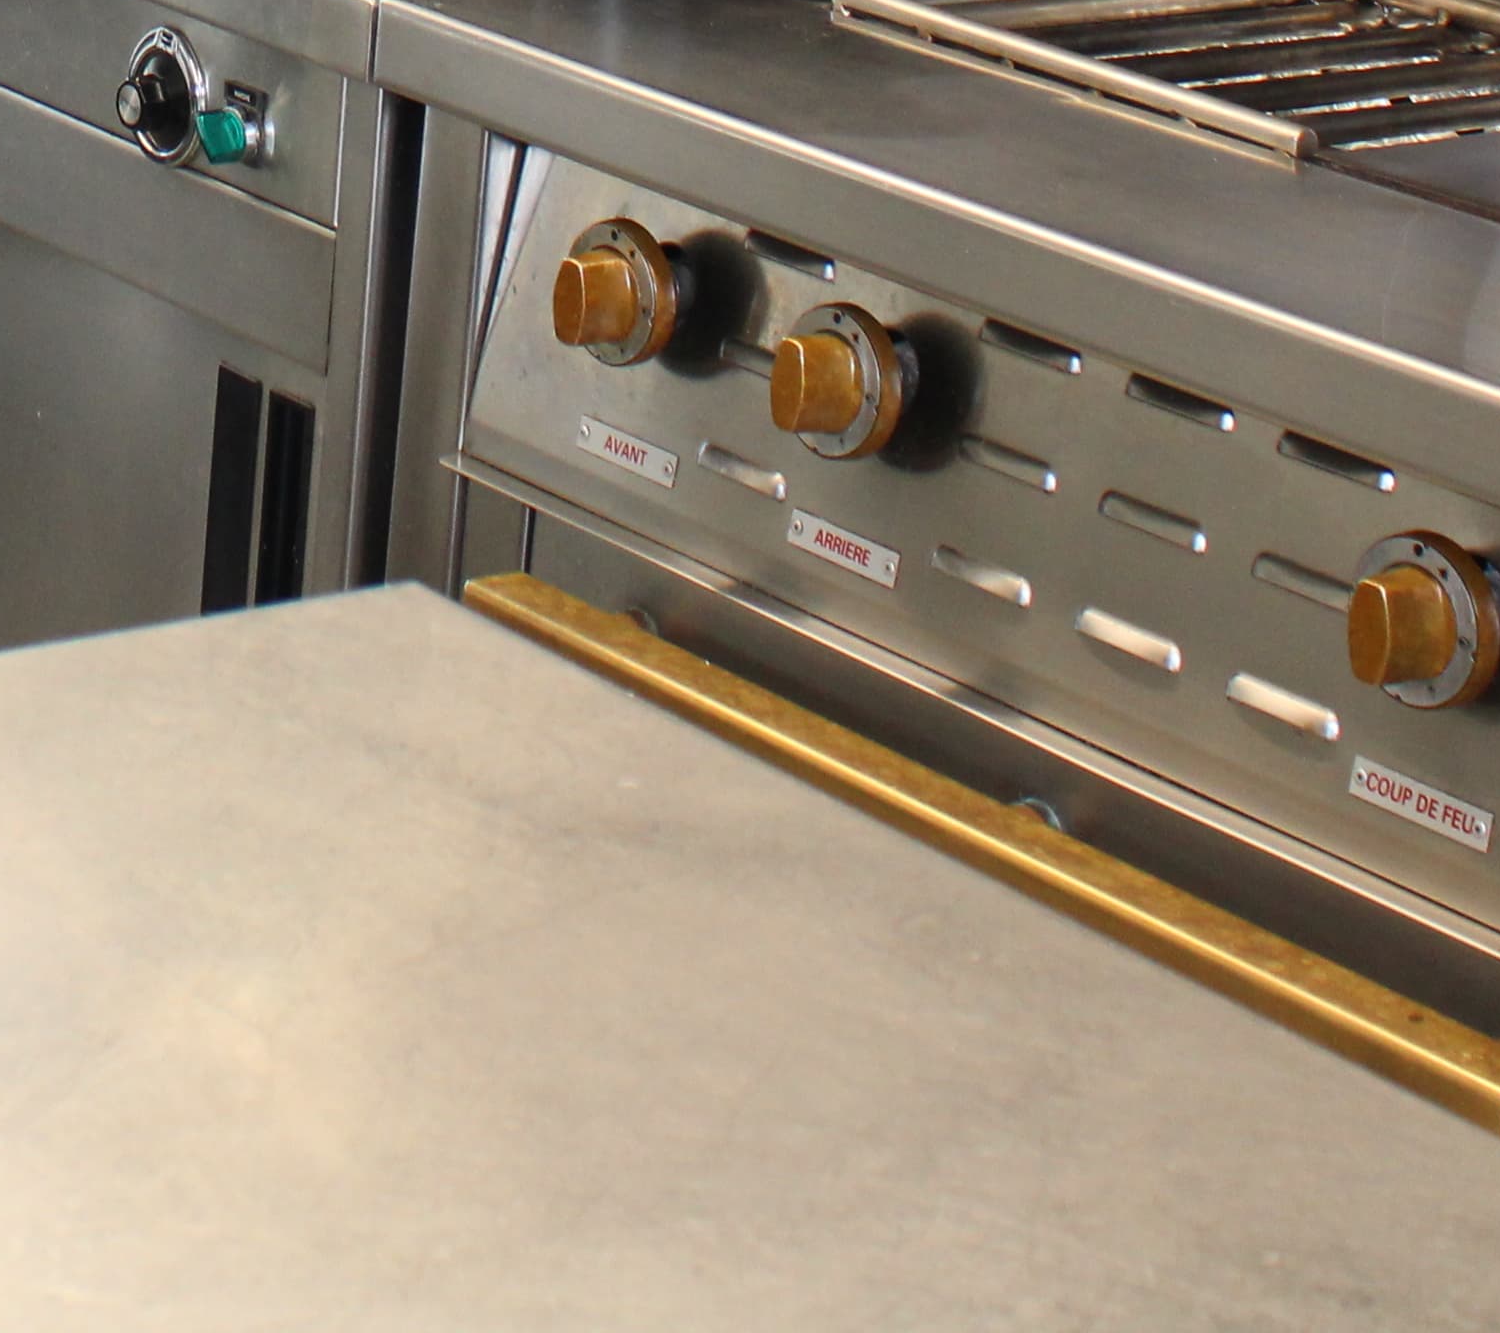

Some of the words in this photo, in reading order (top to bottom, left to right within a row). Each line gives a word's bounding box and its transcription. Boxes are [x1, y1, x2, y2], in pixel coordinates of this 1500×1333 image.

[604, 434, 648, 467] AVANT
[814, 528, 871, 567] ARRIERE
[1366, 772, 1413, 806] COUP
[1416, 794, 1439, 820] DE
[1442, 804, 1475, 835] FEU
